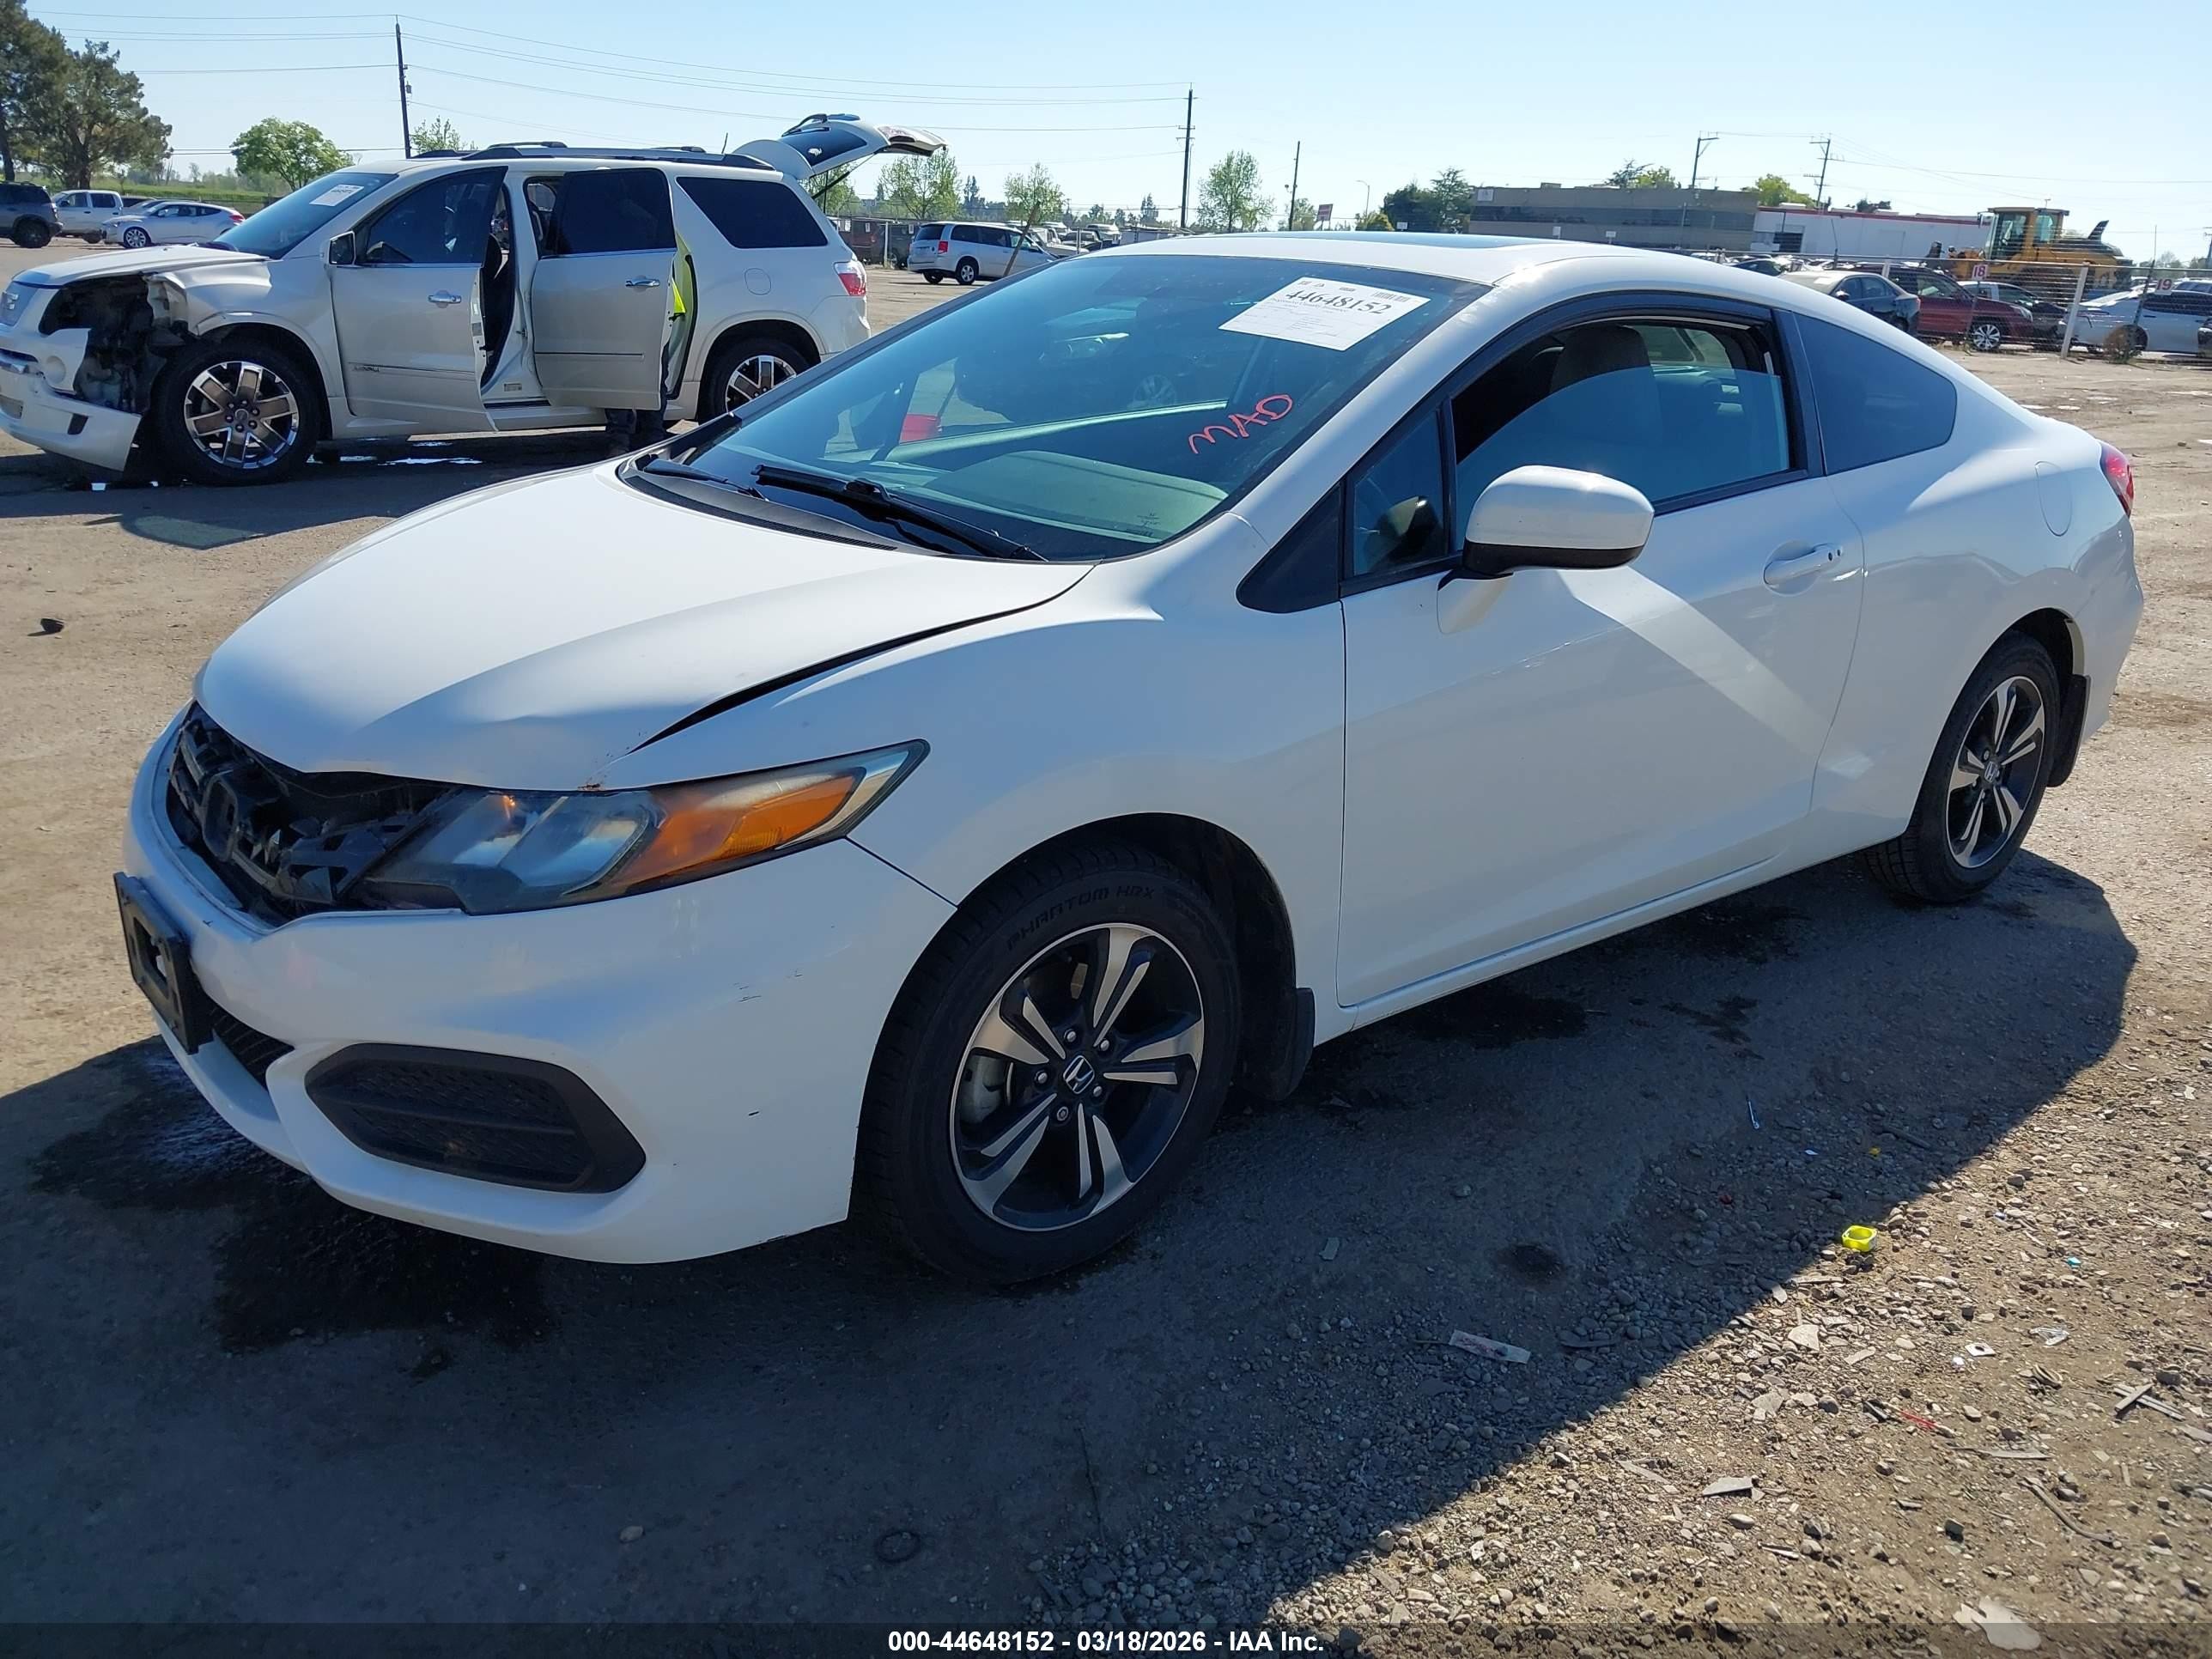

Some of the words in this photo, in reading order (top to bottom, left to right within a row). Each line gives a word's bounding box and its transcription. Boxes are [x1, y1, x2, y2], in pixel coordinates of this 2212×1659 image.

[1973, 265, 1986, 277] 18
[2156, 278, 2172, 290] 19
[1285, 290, 1392, 314] 44648152
